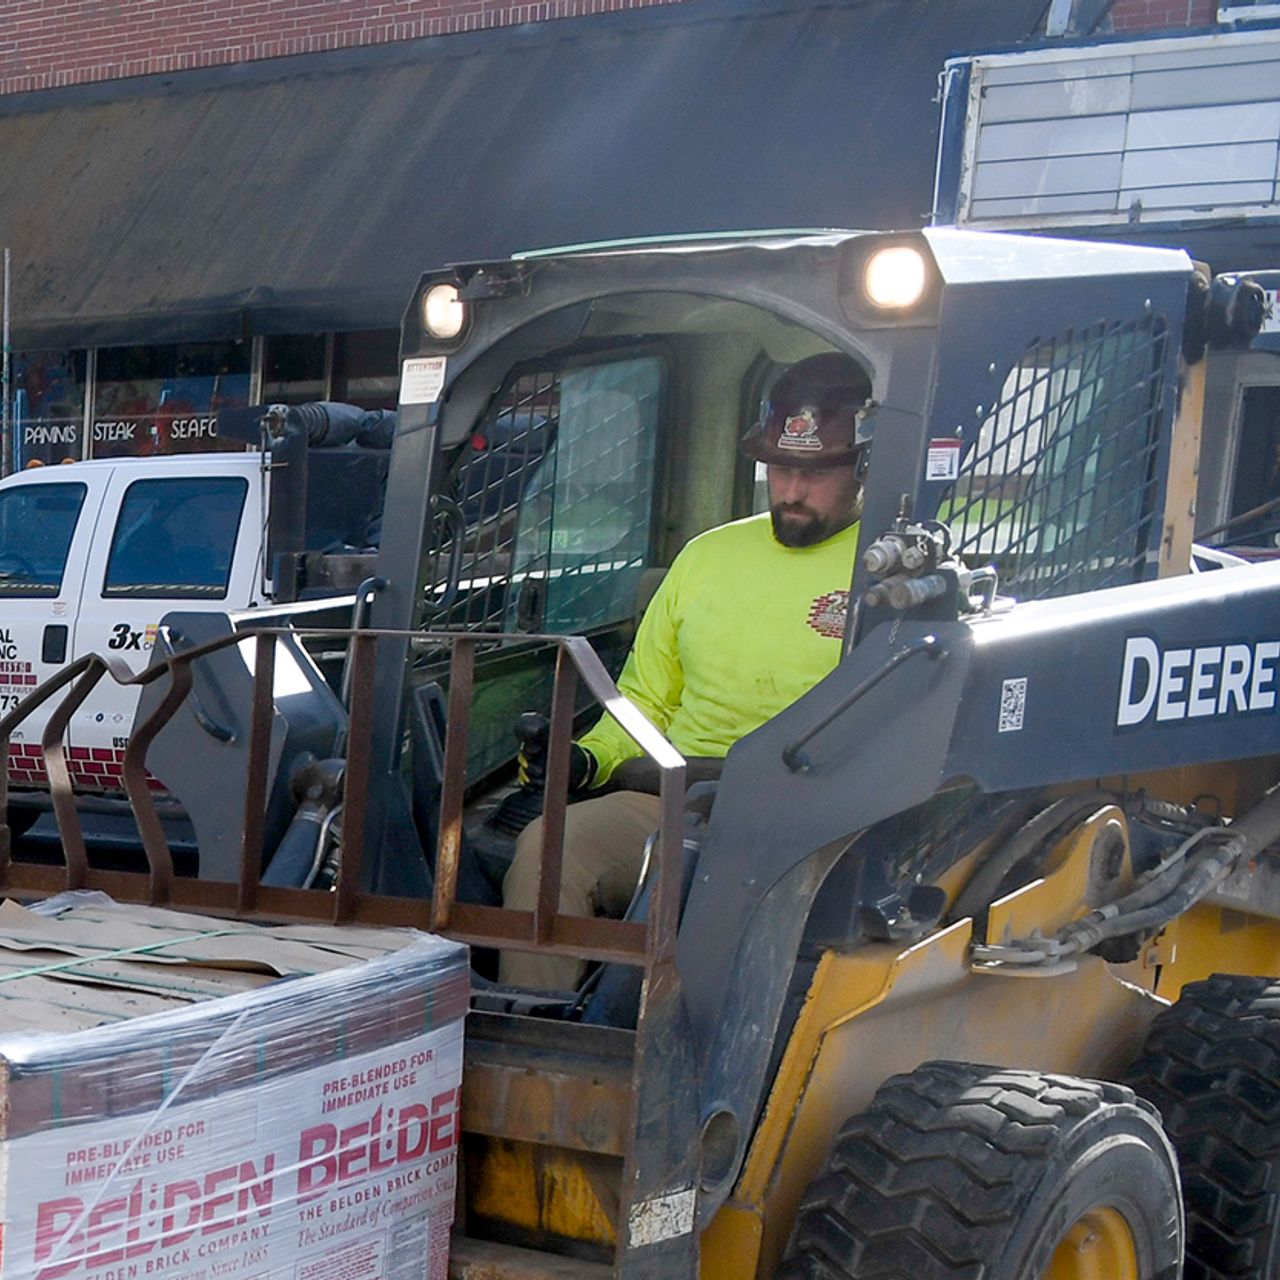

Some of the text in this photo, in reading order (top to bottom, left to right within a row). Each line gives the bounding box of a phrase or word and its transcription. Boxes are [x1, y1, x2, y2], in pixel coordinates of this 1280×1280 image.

[93, 422, 137, 441] STEAK
[108, 624, 143, 651] 3x
[1116, 636, 1280, 726] DEERE
[322, 1049, 433, 1096] PRE-BLENDED FOR
[322, 1072, 417, 1114] IMMEDIATE USE
[177, 1119, 205, 1139] FOR
[156, 1144, 185, 1163] USE
[298, 1204, 323, 1222] THE
[330, 1185, 381, 1212] BELDEN
[387, 1168, 422, 1193] BRICK
[297, 1226, 316, 1248] The
[317, 1209, 368, 1242] Standard
[369, 1204, 380, 1226] of
[382, 1187, 433, 1218] Comparison
[145, 1248, 191, 1274] BRICK
[197, 1223, 270, 1257] COMPANY
[208, 1253, 241, 1279] Since
[240, 1243, 270, 1268] 1885
